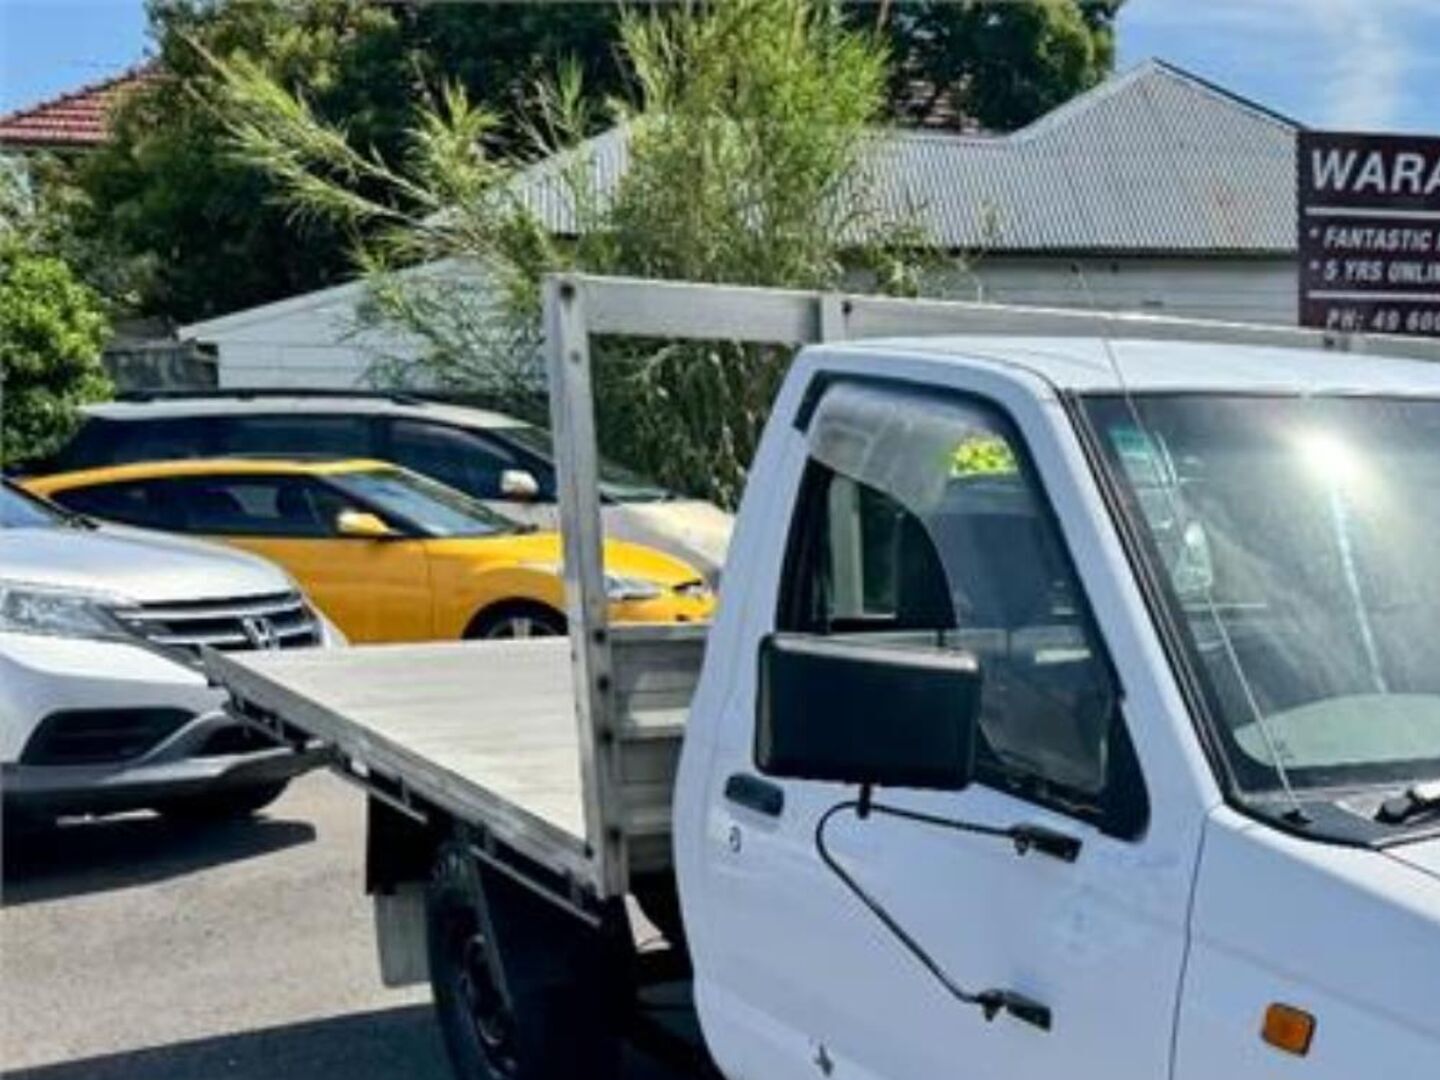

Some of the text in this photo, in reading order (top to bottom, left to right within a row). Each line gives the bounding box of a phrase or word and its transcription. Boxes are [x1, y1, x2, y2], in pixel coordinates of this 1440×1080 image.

[1323, 227, 1432, 250] FANTASTIC
[1344, 260, 1383, 282] YRS
[1326, 308, 1364, 331] PH:
[1372, 310, 1400, 330] 49
